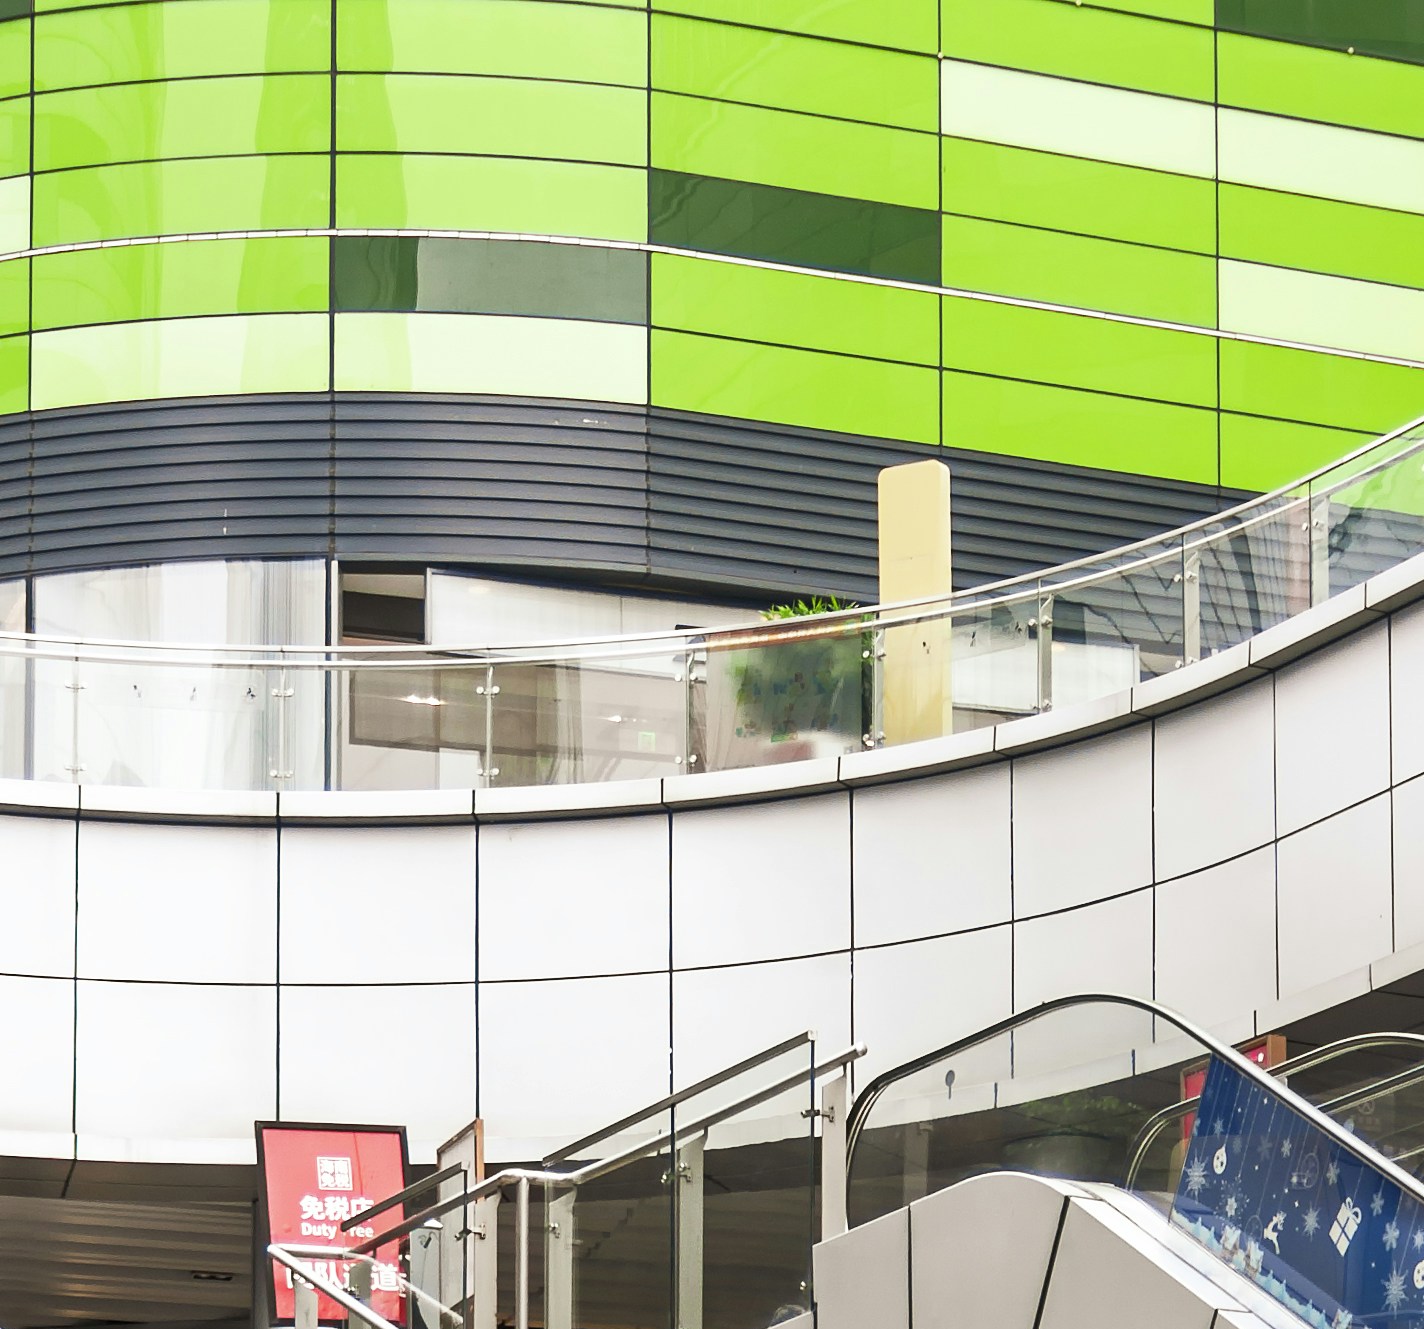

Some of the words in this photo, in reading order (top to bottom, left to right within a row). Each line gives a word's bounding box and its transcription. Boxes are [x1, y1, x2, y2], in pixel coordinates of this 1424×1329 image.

[301, 1223, 337, 1239] Duty
[343, 1226, 374, 1237] ree
[286, 1260, 399, 1291] 队道
